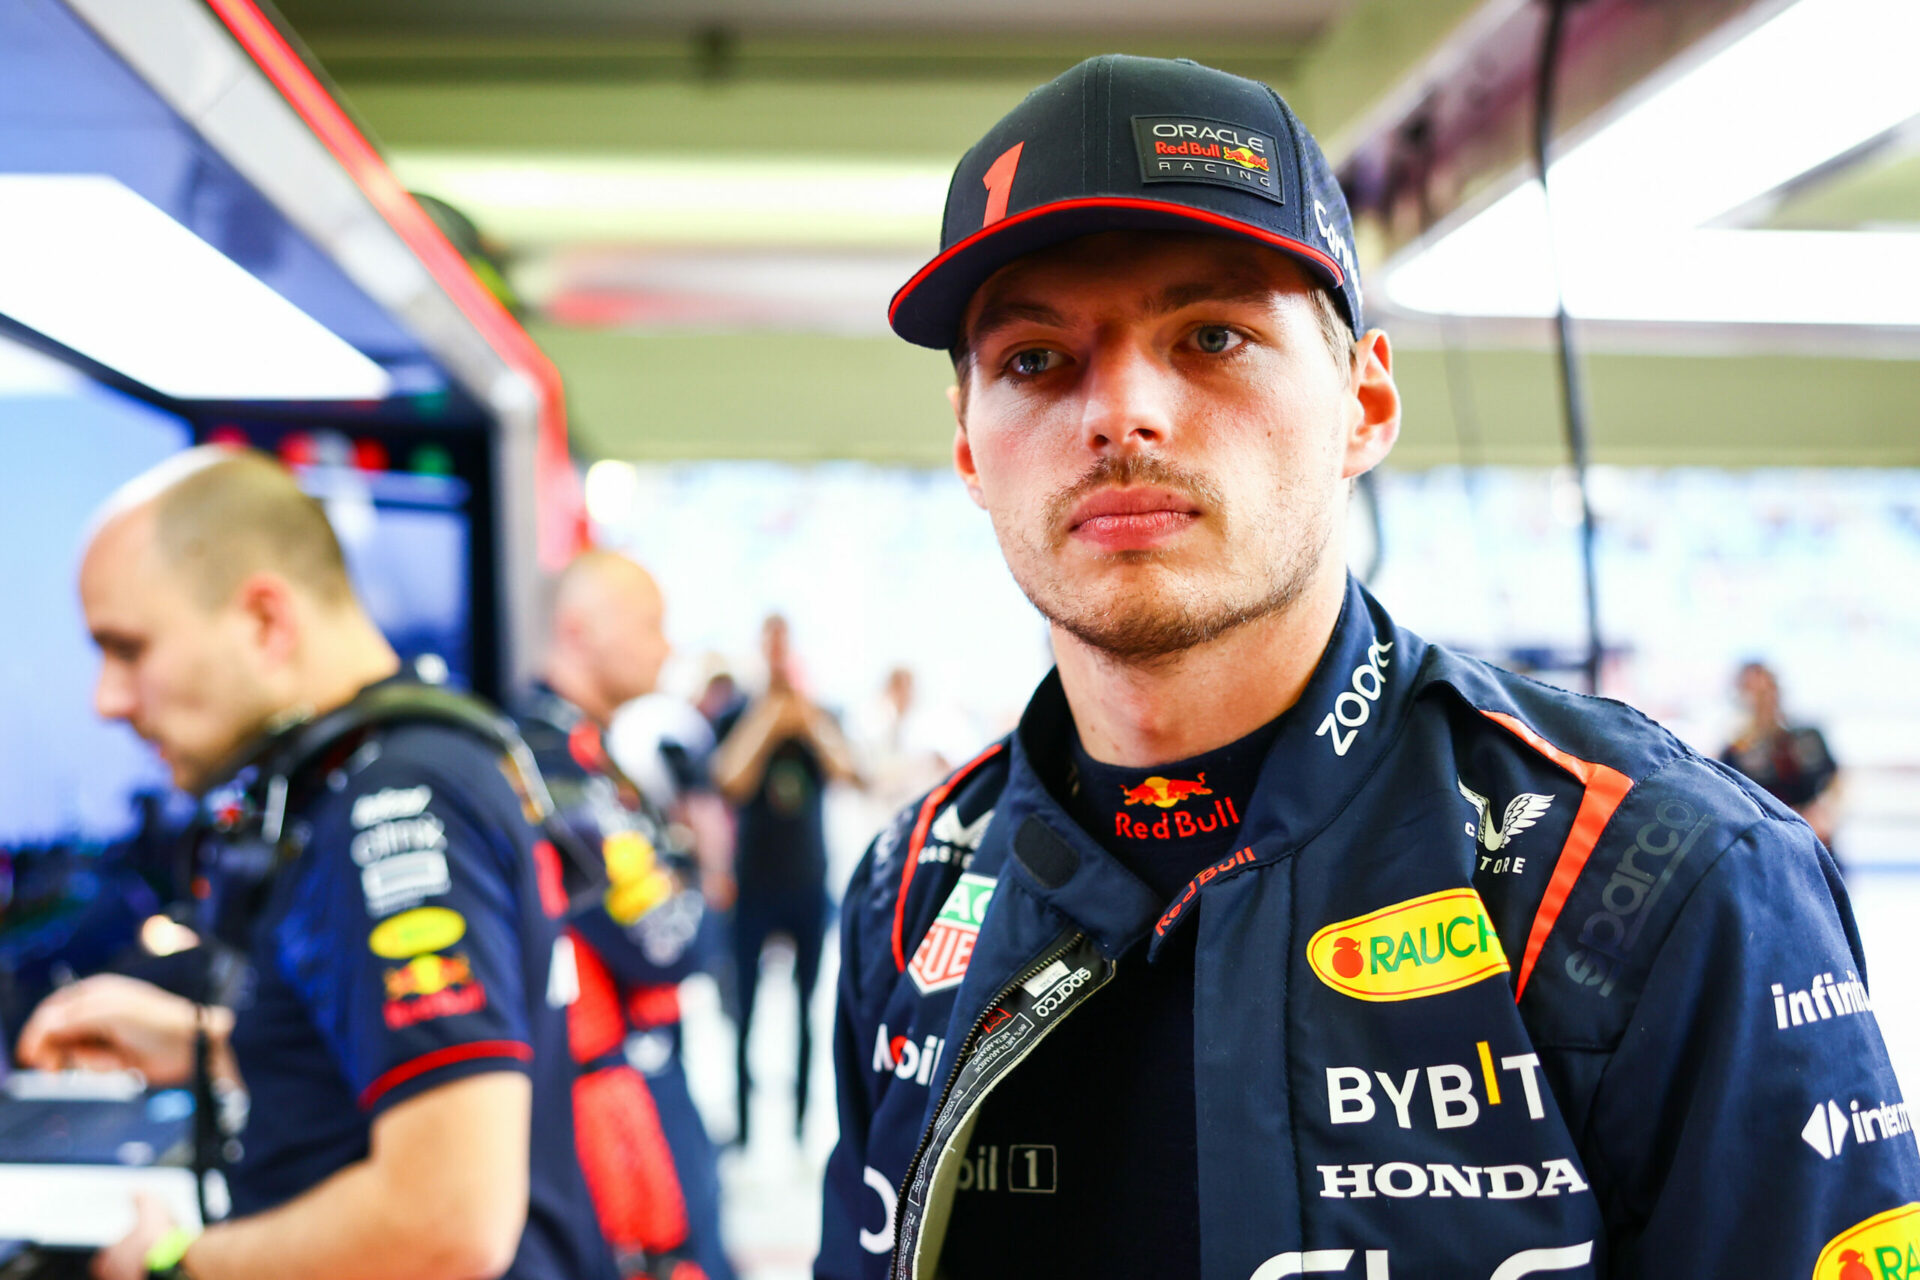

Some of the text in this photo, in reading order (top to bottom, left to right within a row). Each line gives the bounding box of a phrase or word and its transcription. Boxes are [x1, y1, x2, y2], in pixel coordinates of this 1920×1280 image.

[1153, 124, 1264, 153] ORACLE
[1155, 141, 1220, 158] Red Bull
[982, 141, 1025, 229] 1
[1158, 162, 1270, 187] RACING
[1115, 797, 1240, 839] Red Bull
[1155, 846, 1256, 937] Red Bull
[1564, 801, 1694, 983] sparco
[1033, 967, 1092, 1017] sparco
[1325, 1041, 1545, 1129] BYBIT
[1316, 1158, 1589, 1199] HONDA
